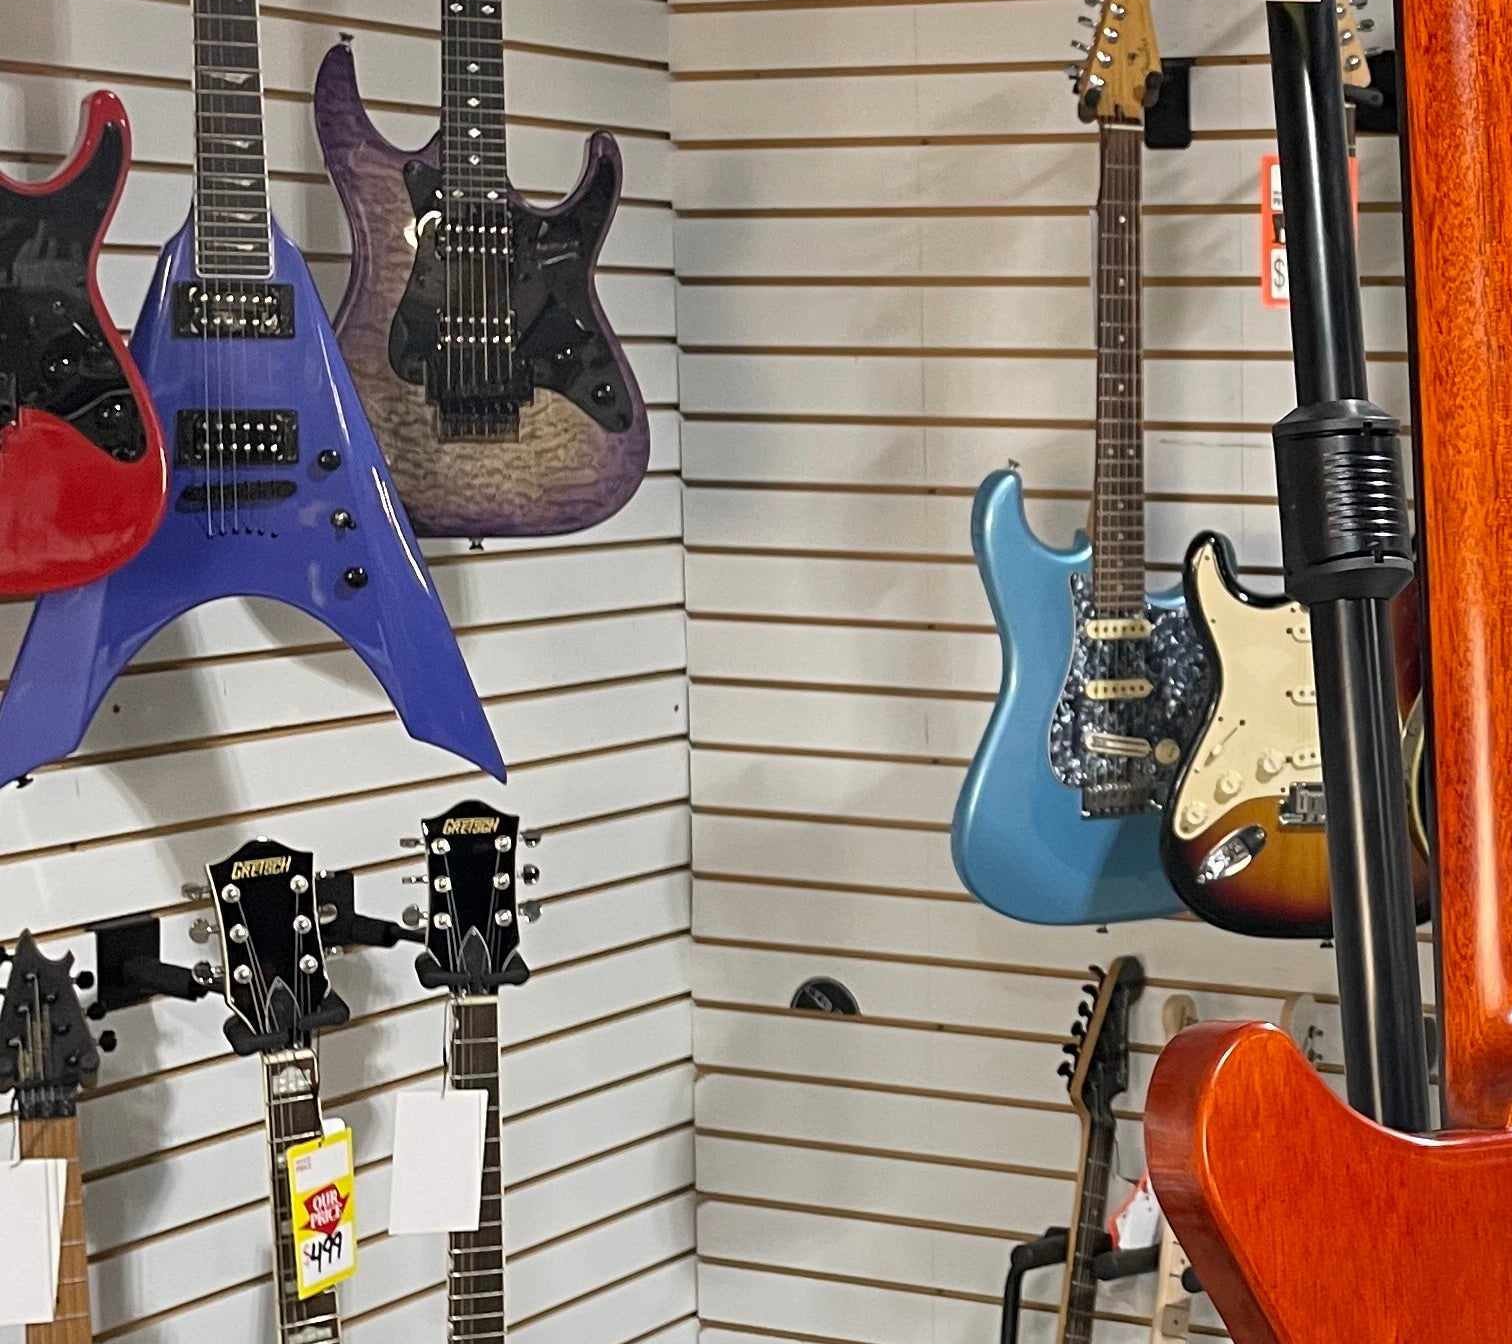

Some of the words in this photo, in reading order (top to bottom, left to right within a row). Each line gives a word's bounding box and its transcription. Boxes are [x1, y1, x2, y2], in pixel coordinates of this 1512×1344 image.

[442, 817, 500, 836] GRETSCH
[231, 856, 292, 881] GRETSCH
[312, 1188, 340, 1211] OUR
[310, 1202, 343, 1230] PRICE
